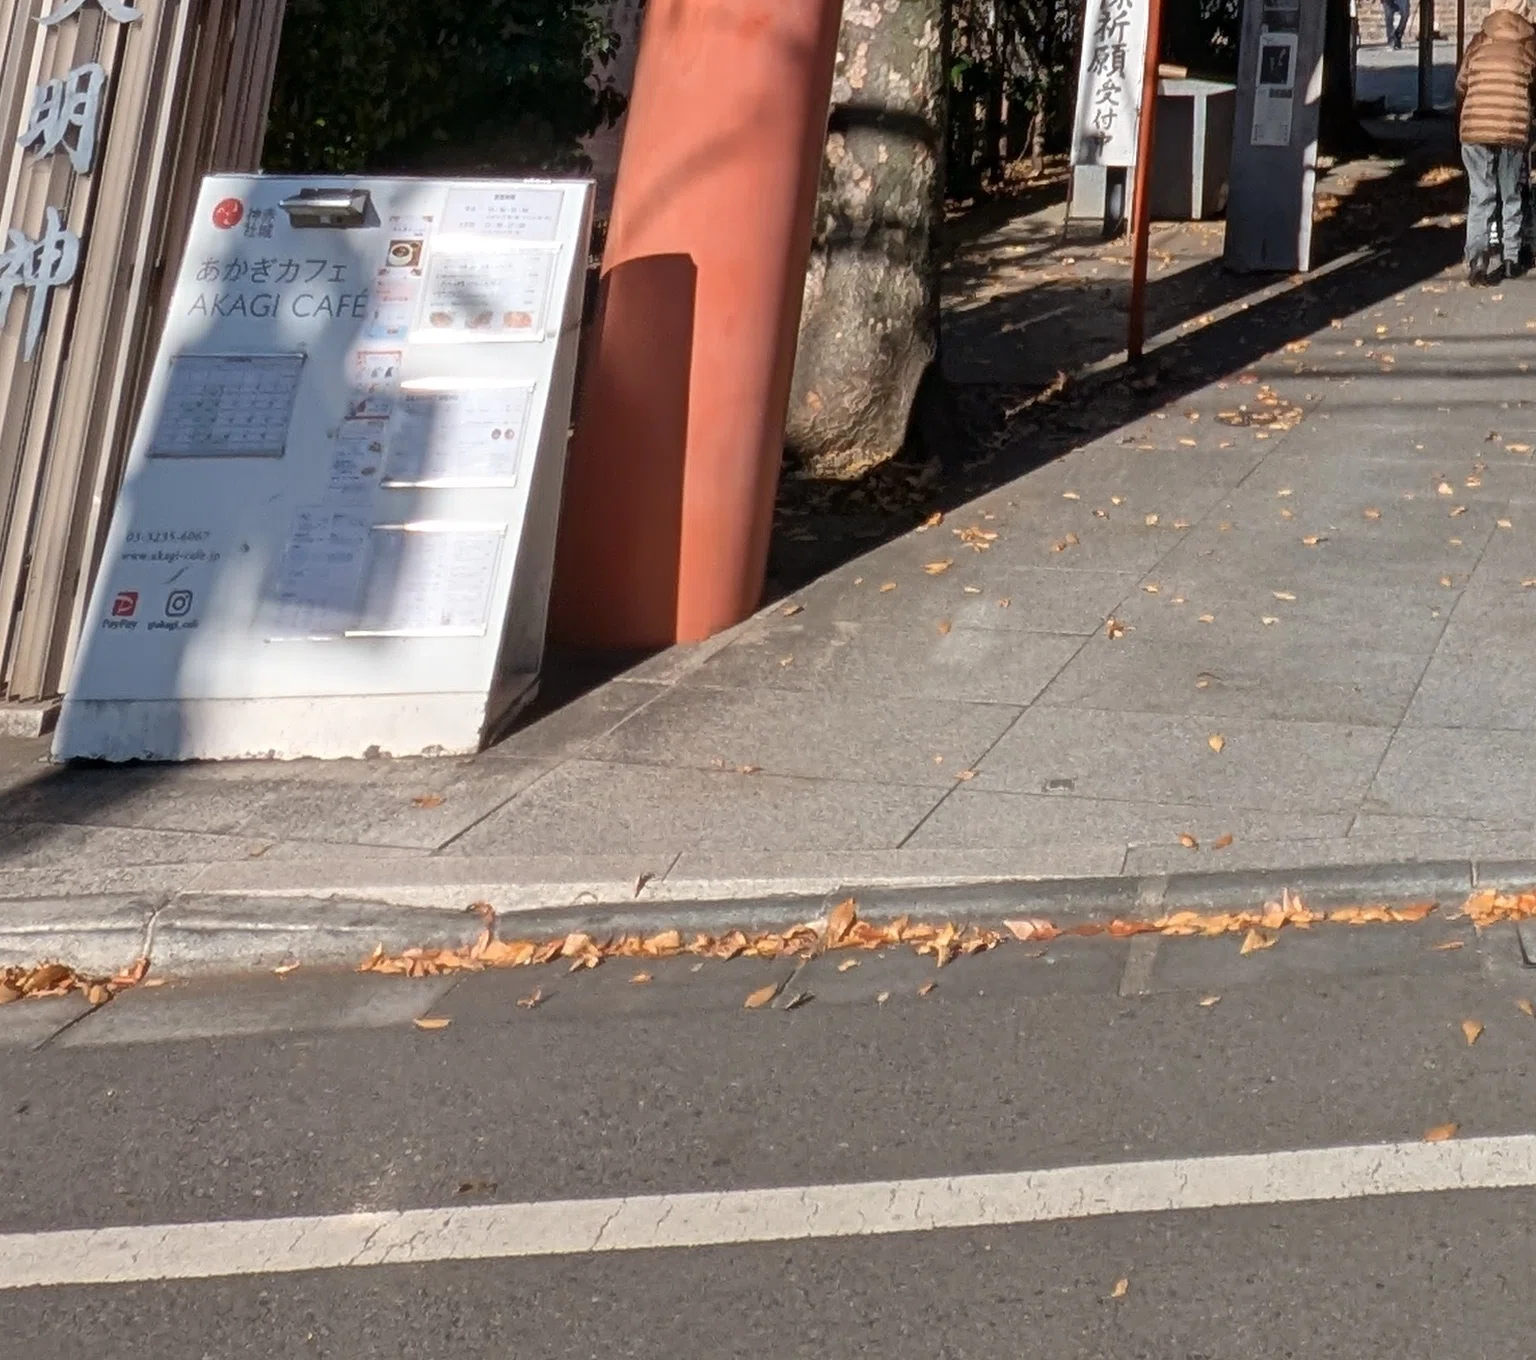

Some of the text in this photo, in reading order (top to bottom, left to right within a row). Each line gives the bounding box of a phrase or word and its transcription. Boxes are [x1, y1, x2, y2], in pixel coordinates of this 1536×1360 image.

[196, 256, 348, 284] あかぎカフェ
[187, 293, 281, 318] AKAGI
[291, 288, 369, 319] CAFÉ
